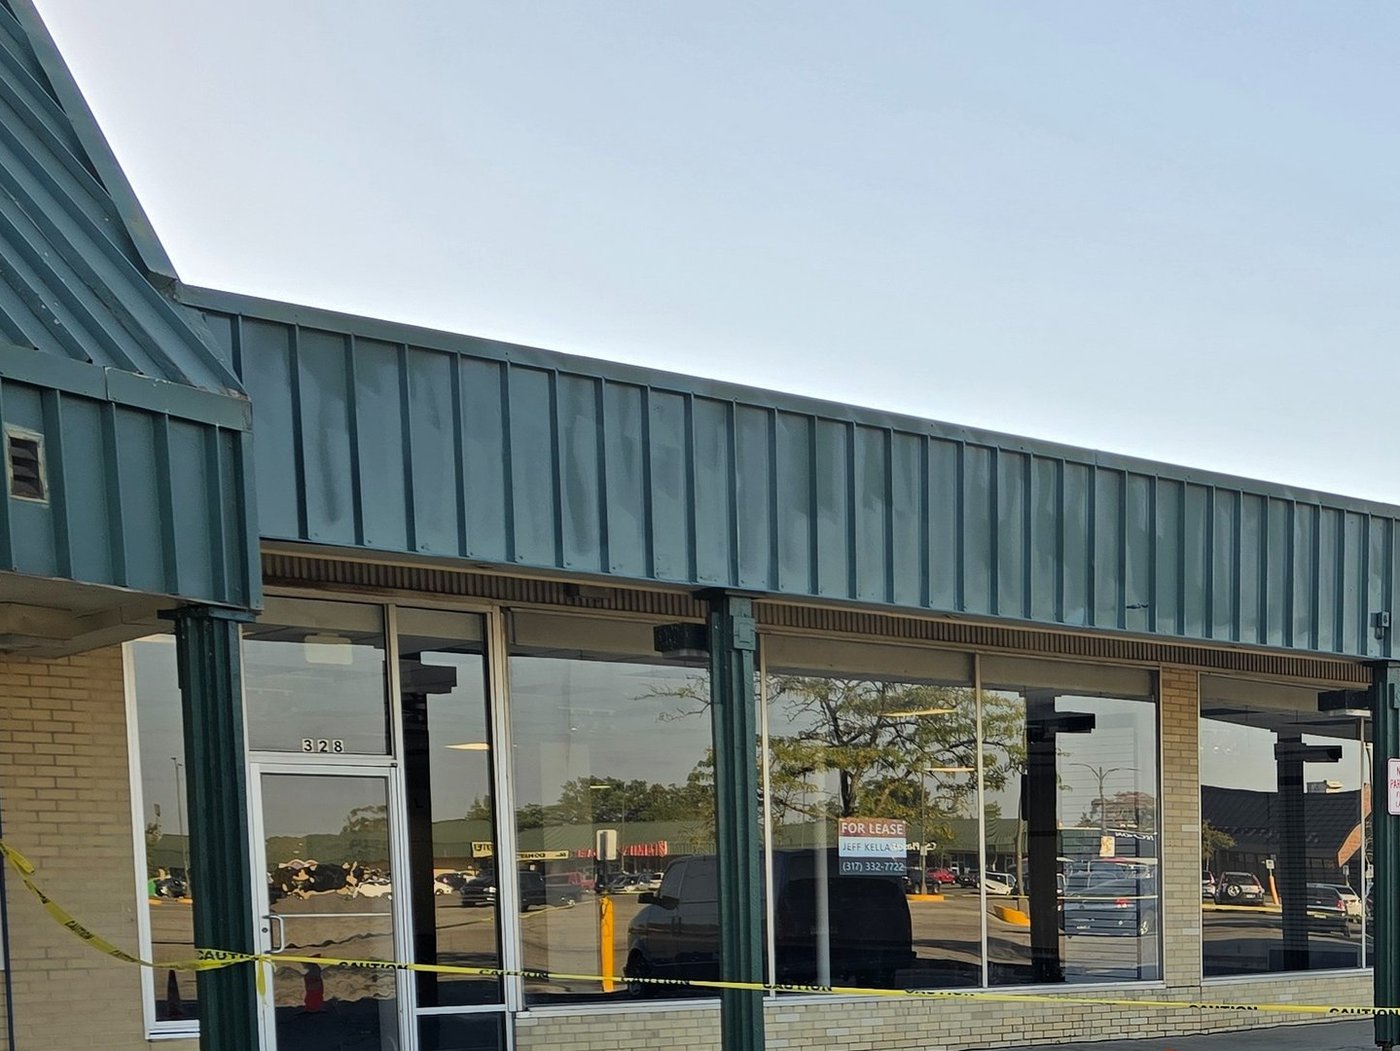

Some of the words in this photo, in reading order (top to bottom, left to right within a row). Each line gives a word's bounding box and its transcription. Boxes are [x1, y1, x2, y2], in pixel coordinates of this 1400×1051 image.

[303, 739, 343, 753] 328
[841, 822, 866, 834] FOR
[869, 823, 904, 835] LEASE
[842, 842, 862, 852] JEFF
[842, 861, 863, 872] (317)
[865, 862, 904, 872] 332-7722
